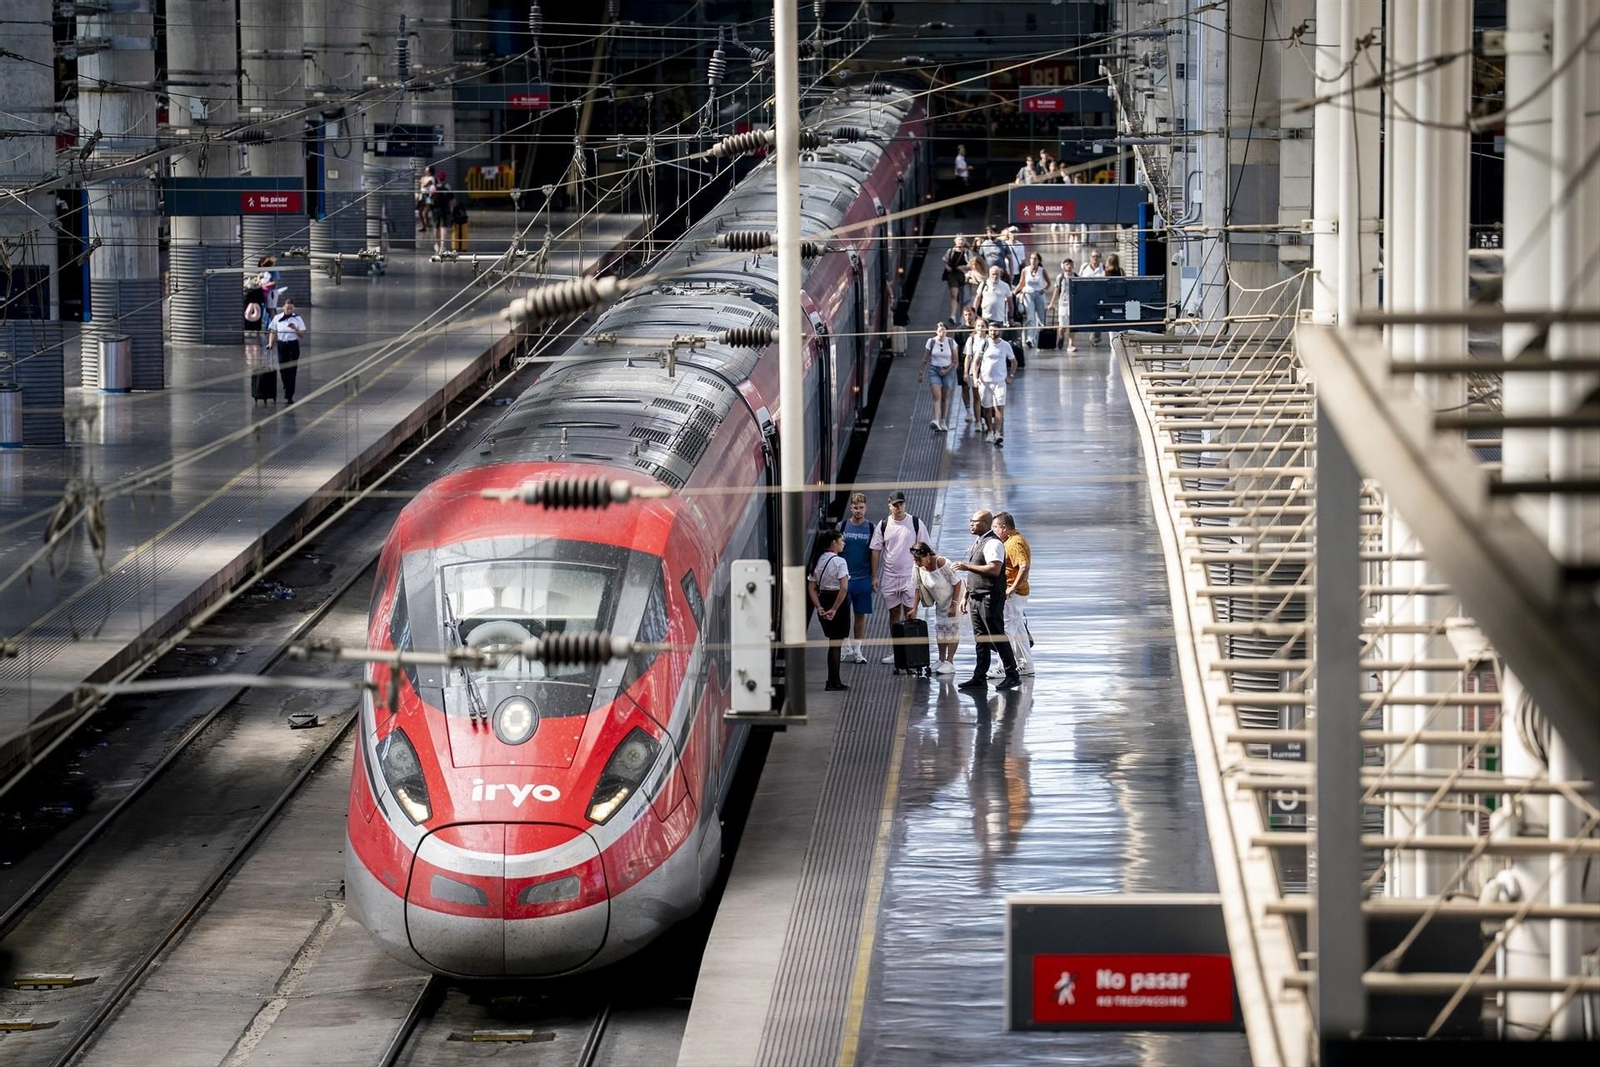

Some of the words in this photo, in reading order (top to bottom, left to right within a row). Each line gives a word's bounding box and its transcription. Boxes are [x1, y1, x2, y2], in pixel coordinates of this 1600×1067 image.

[471, 778, 561, 808] iryo
[1096, 969, 1126, 990] No
[1130, 972, 1191, 994] pasar
